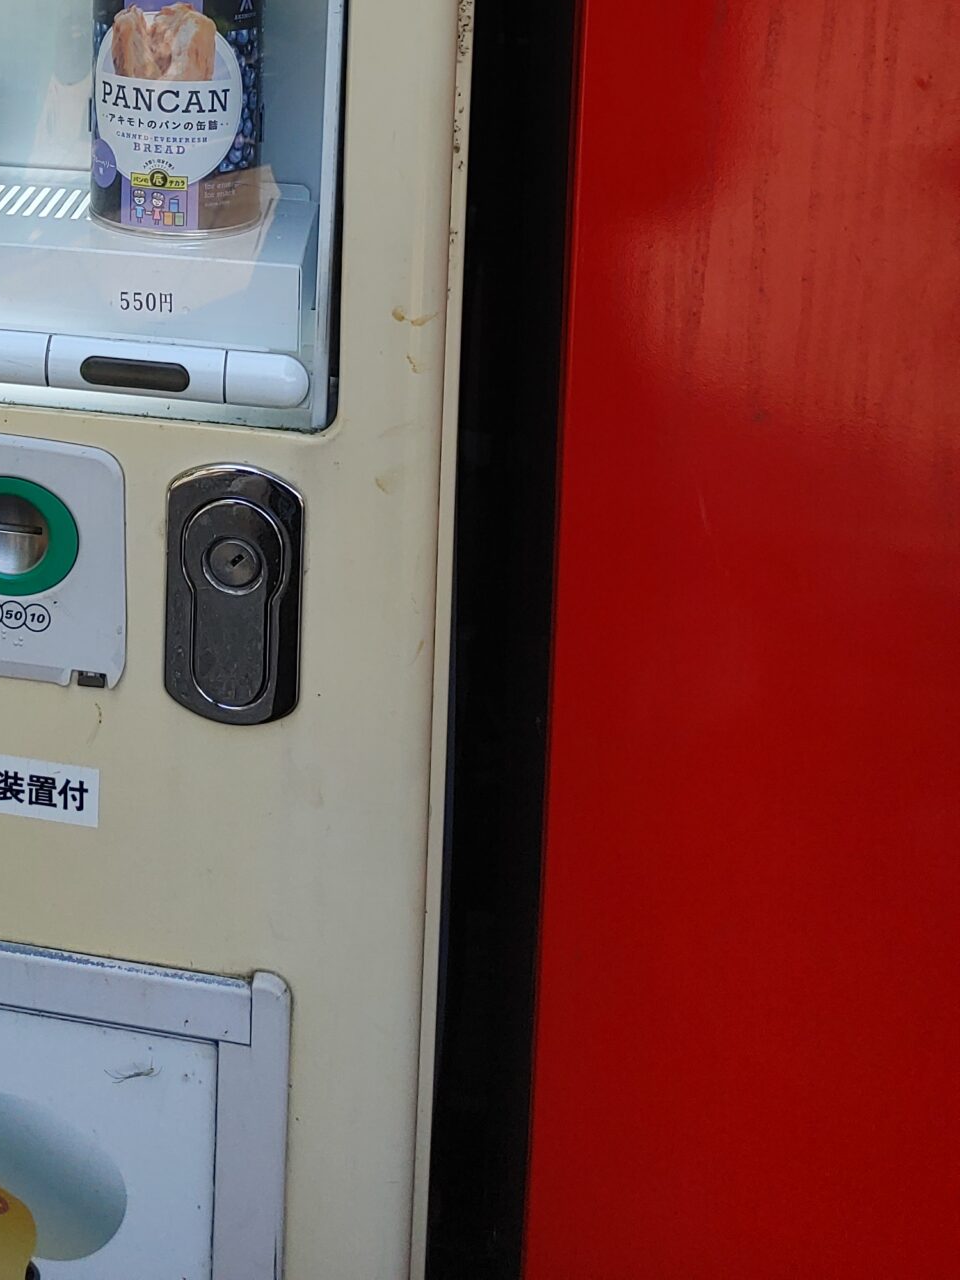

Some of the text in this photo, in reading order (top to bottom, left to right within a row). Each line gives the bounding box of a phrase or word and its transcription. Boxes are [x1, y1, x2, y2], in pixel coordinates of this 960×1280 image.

[102, 81, 230, 114] PANCAN
[108, 113, 219, 131] アキモトのパンの缶詰
[133, 142, 186, 155] BREAD
[120, 291, 173, 314] 550円
[5, 609, 23, 621] 50
[29, 612, 46, 624] 10
